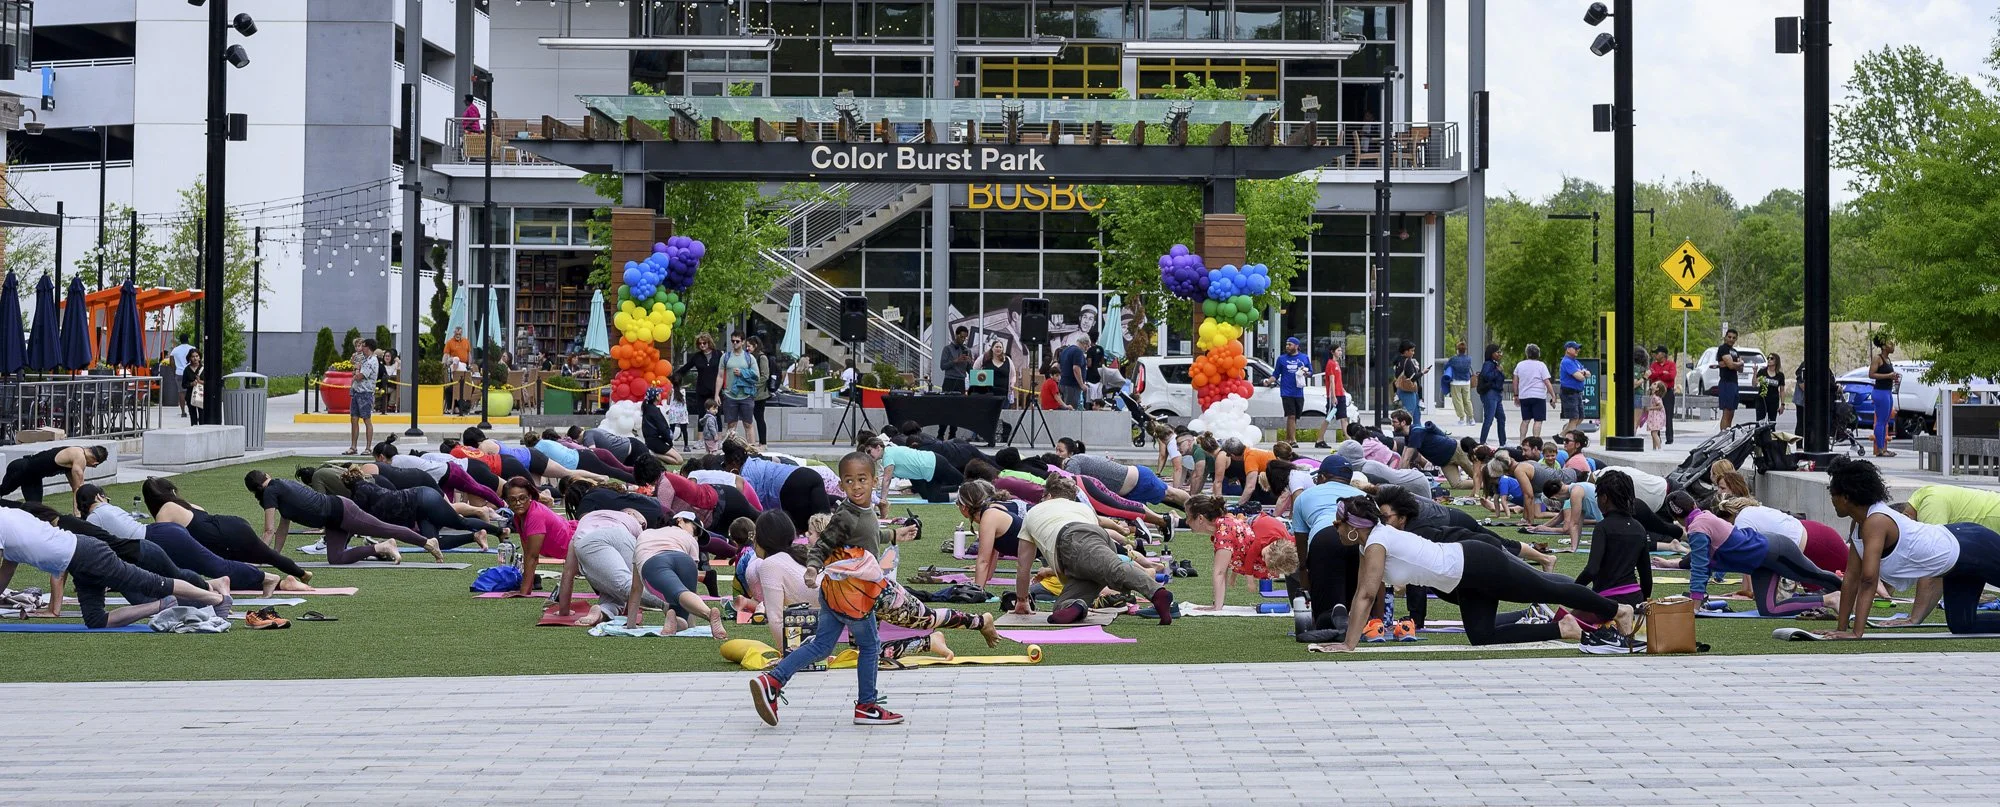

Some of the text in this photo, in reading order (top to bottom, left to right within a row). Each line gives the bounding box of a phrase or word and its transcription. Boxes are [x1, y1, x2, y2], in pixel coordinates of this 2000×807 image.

[811, 145, 1046, 172] Color Burst Park
